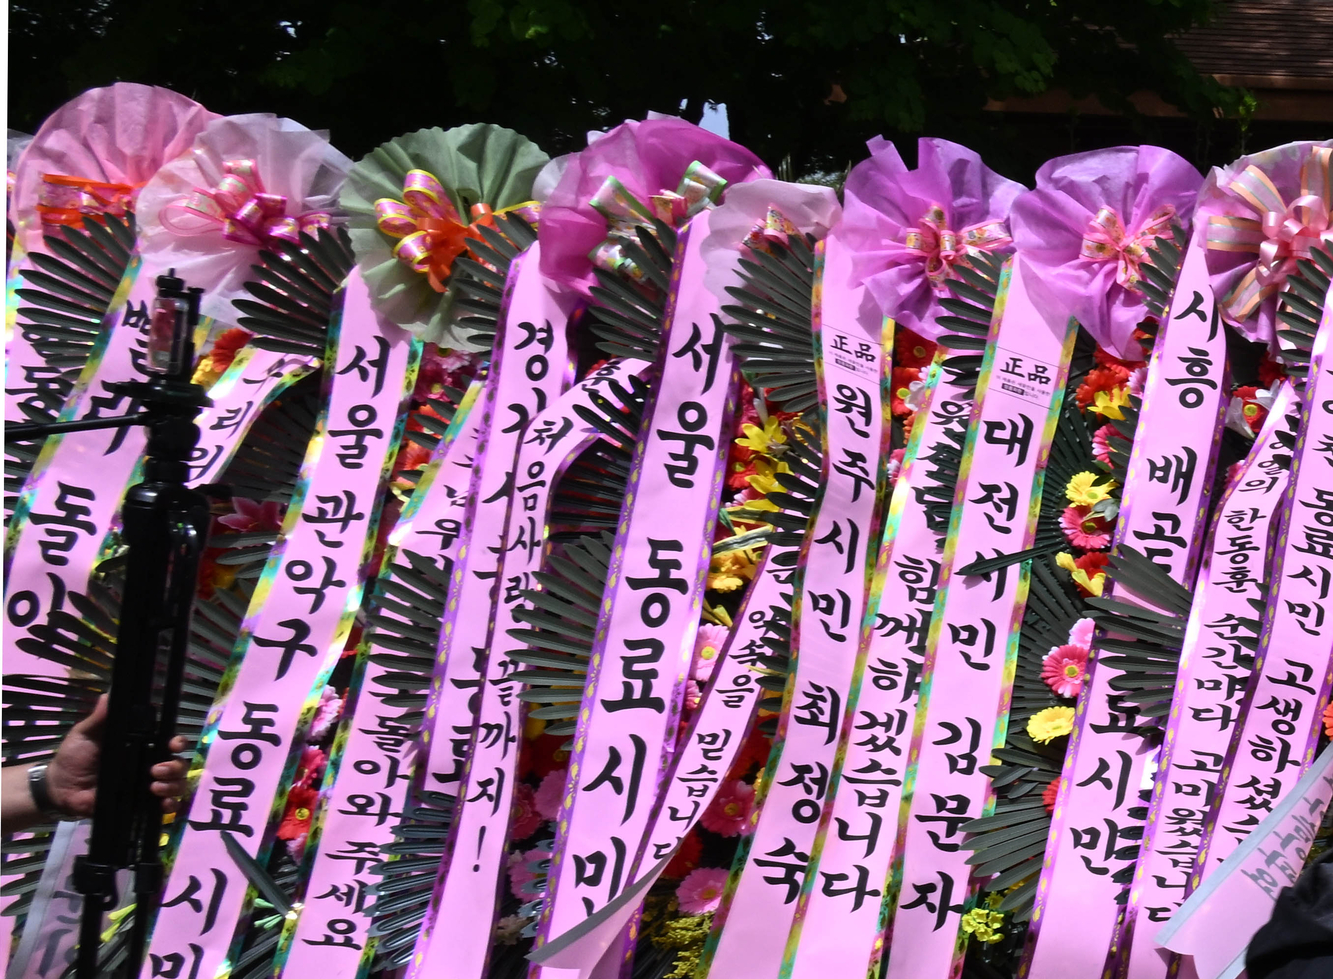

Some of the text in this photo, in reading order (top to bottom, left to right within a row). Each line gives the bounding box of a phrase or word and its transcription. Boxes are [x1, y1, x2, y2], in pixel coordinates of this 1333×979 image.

[327, 335, 391, 470] 서울
[655, 312, 725, 490] 서울
[829, 334, 877, 363] 正品
[999, 356, 1052, 385] 正品
[1164, 284, 1219, 410] 시흥
[253, 489, 365, 681] 관악구
[1212, 506, 1268, 594] 한동훈
[188, 700, 283, 838] 동료
[335, 714, 412, 827] 돌아와
[466, 660, 521, 873] 끝까지!
[752, 679, 841, 906] 최정숙
[899, 715, 982, 933] 김문자
[301, 839, 387, 952] 주세요
